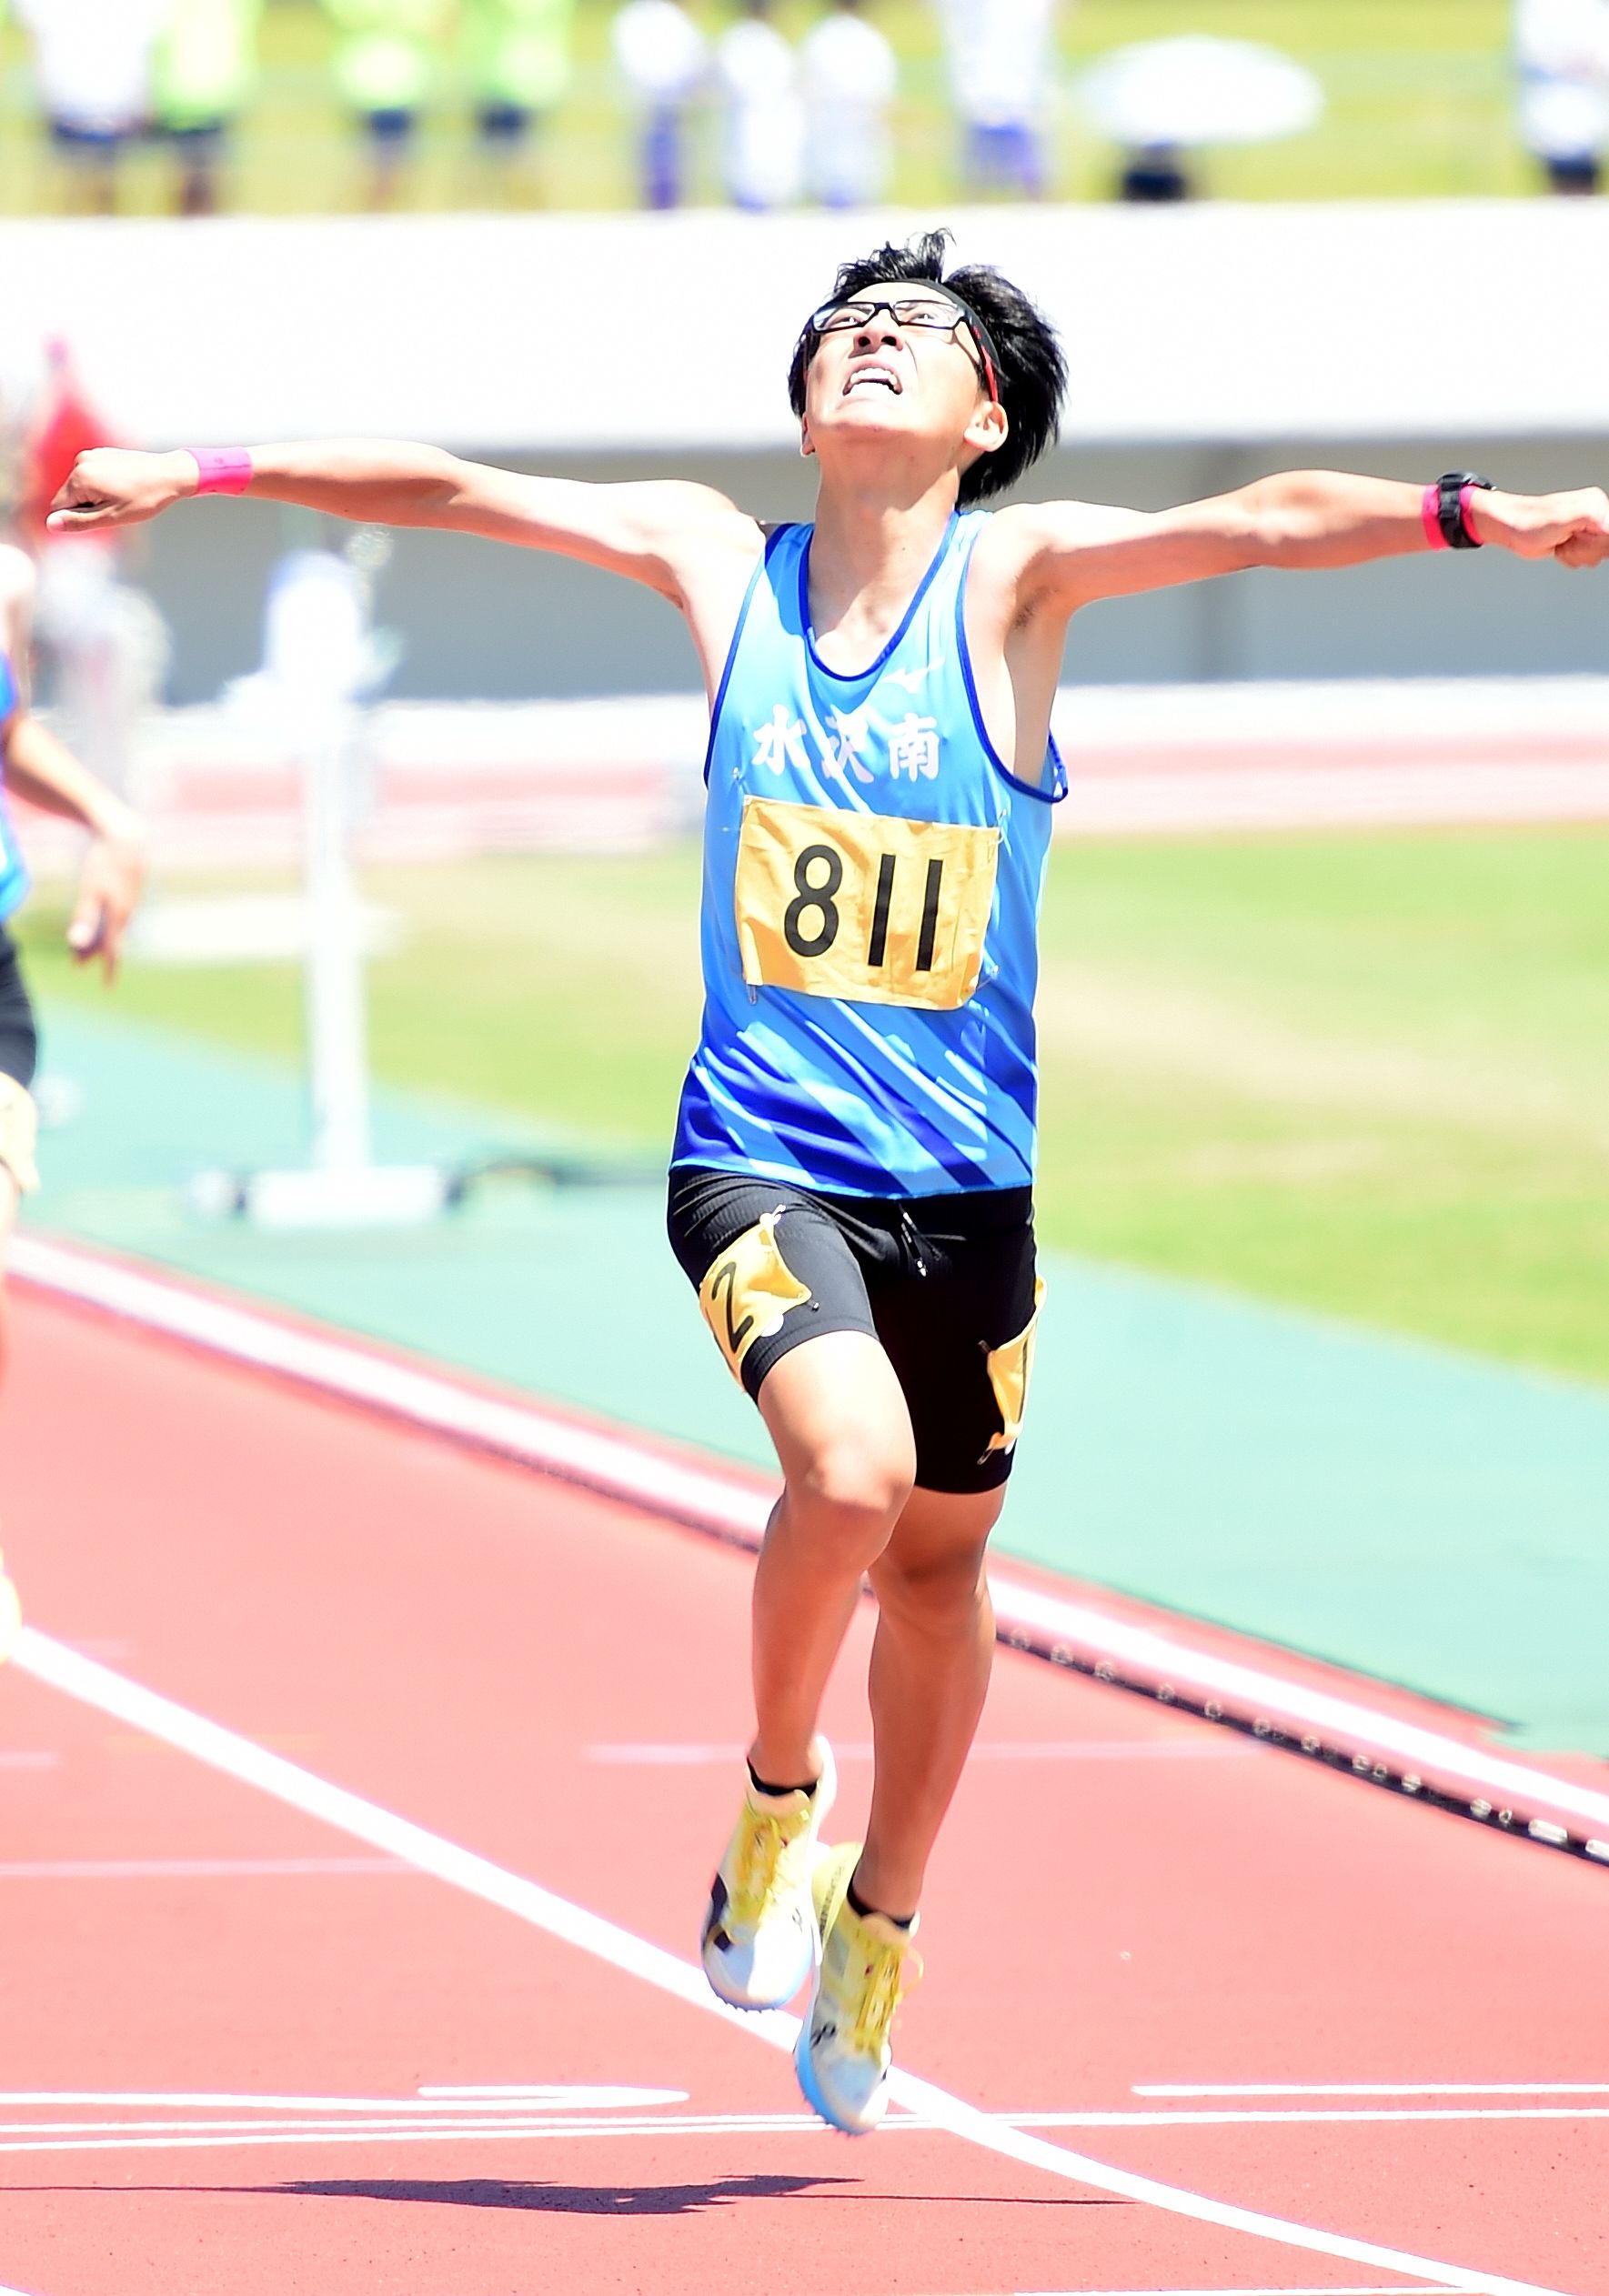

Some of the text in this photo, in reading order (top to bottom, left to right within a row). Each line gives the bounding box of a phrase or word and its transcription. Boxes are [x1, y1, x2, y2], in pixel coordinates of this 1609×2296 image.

[751, 703, 940, 783] 水沢南
[784, 844, 942, 971] 811
[711, 1261, 754, 1353] 2
